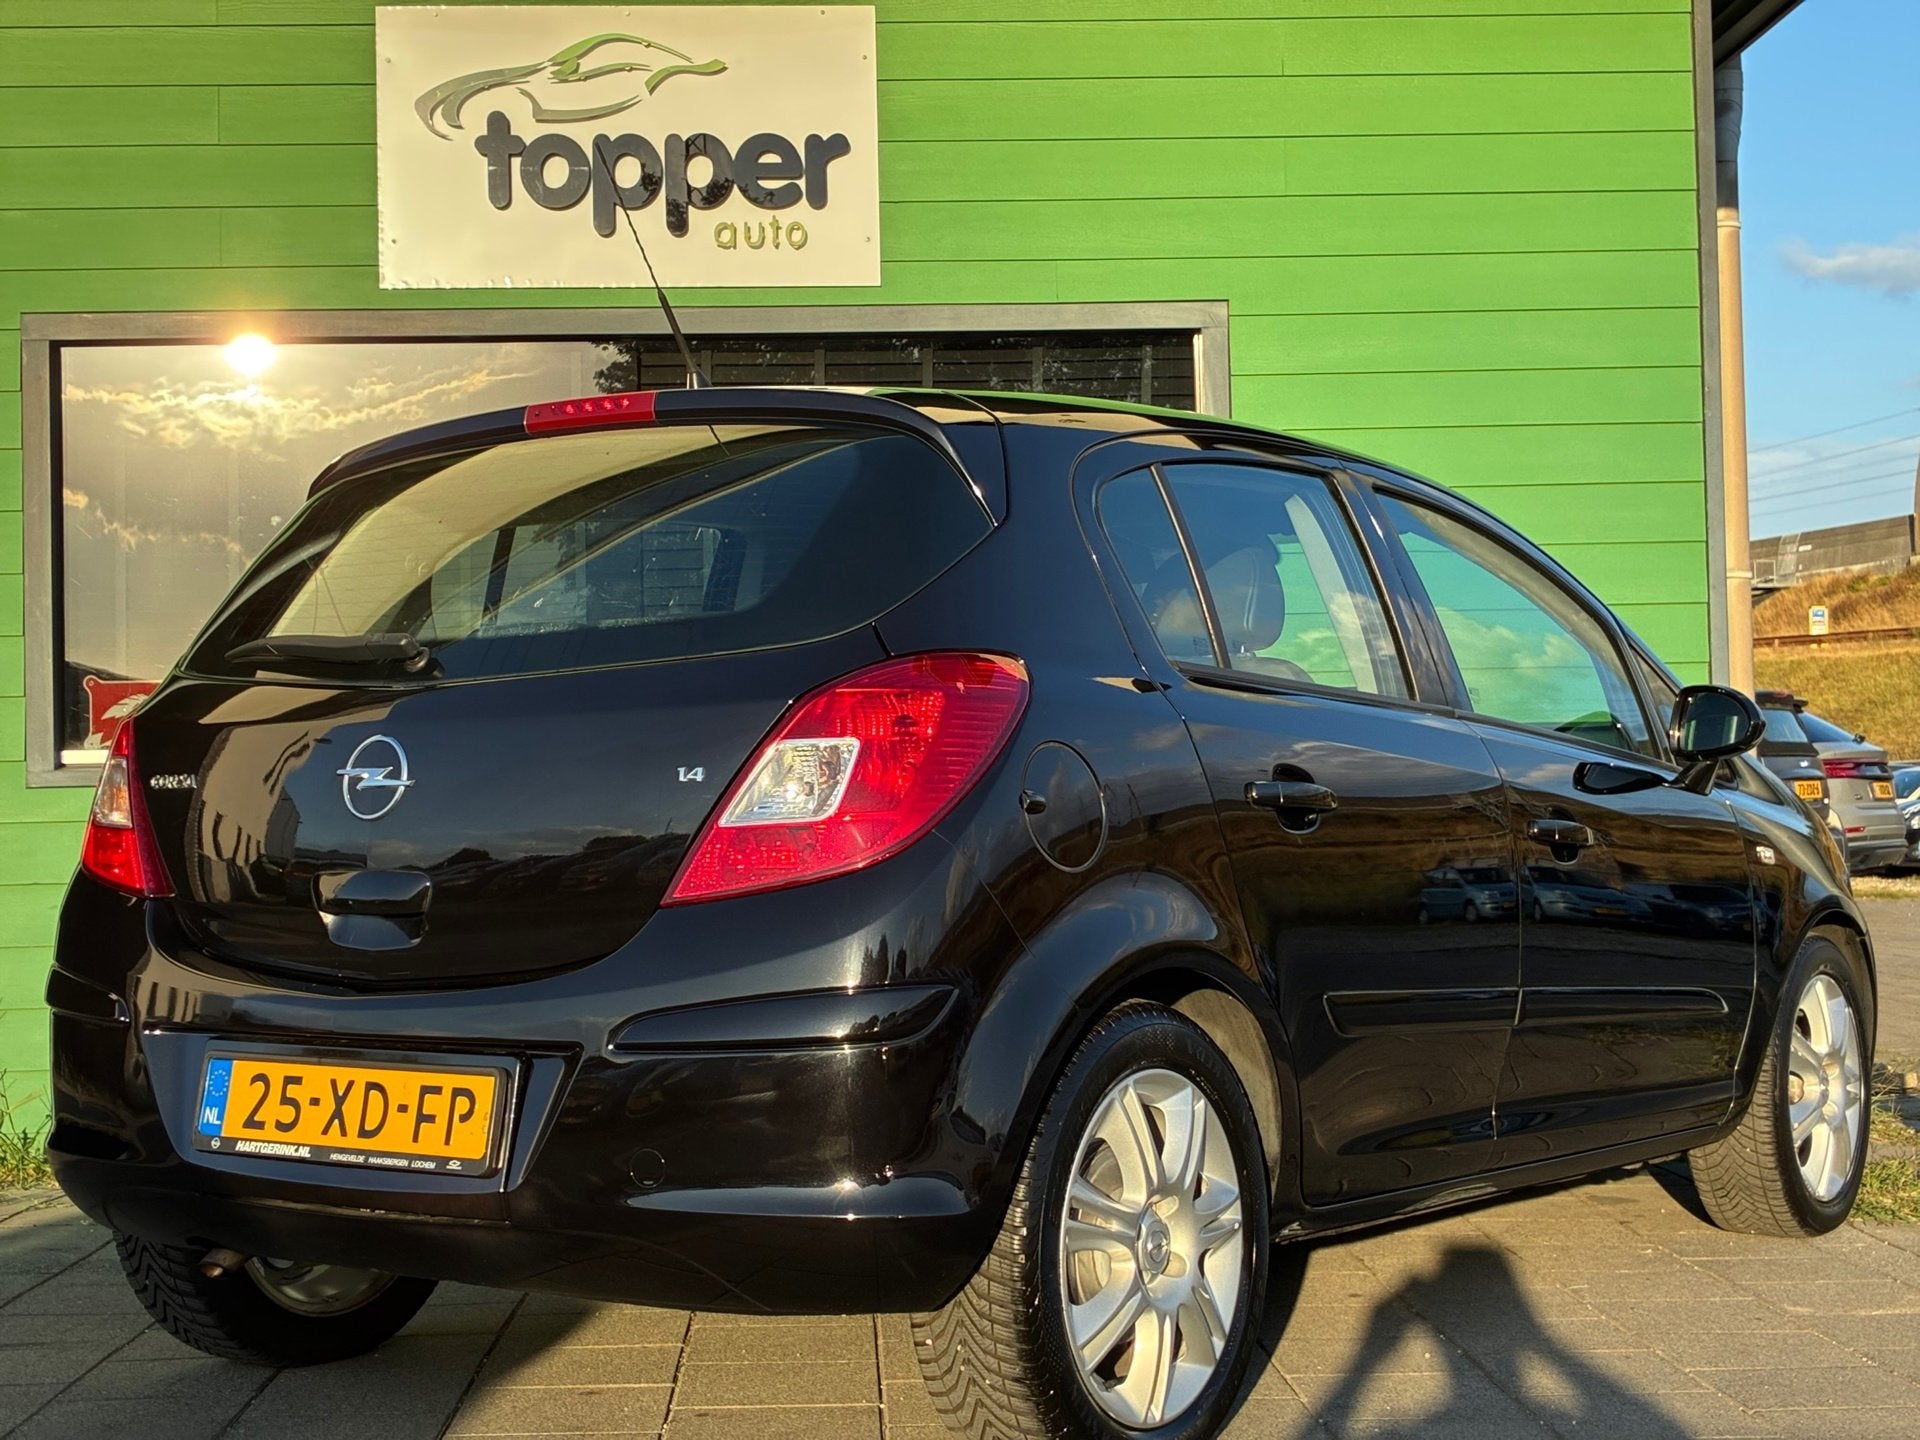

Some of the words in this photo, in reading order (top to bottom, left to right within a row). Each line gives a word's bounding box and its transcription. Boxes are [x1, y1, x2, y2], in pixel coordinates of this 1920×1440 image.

[475, 110, 851, 238] topper
[713, 214, 808, 250] auto
[203, 1105, 221, 1125] NL
[242, 1072, 477, 1146] 25-XD-FP
[235, 1140, 311, 1158] HARTGERINK.NL
